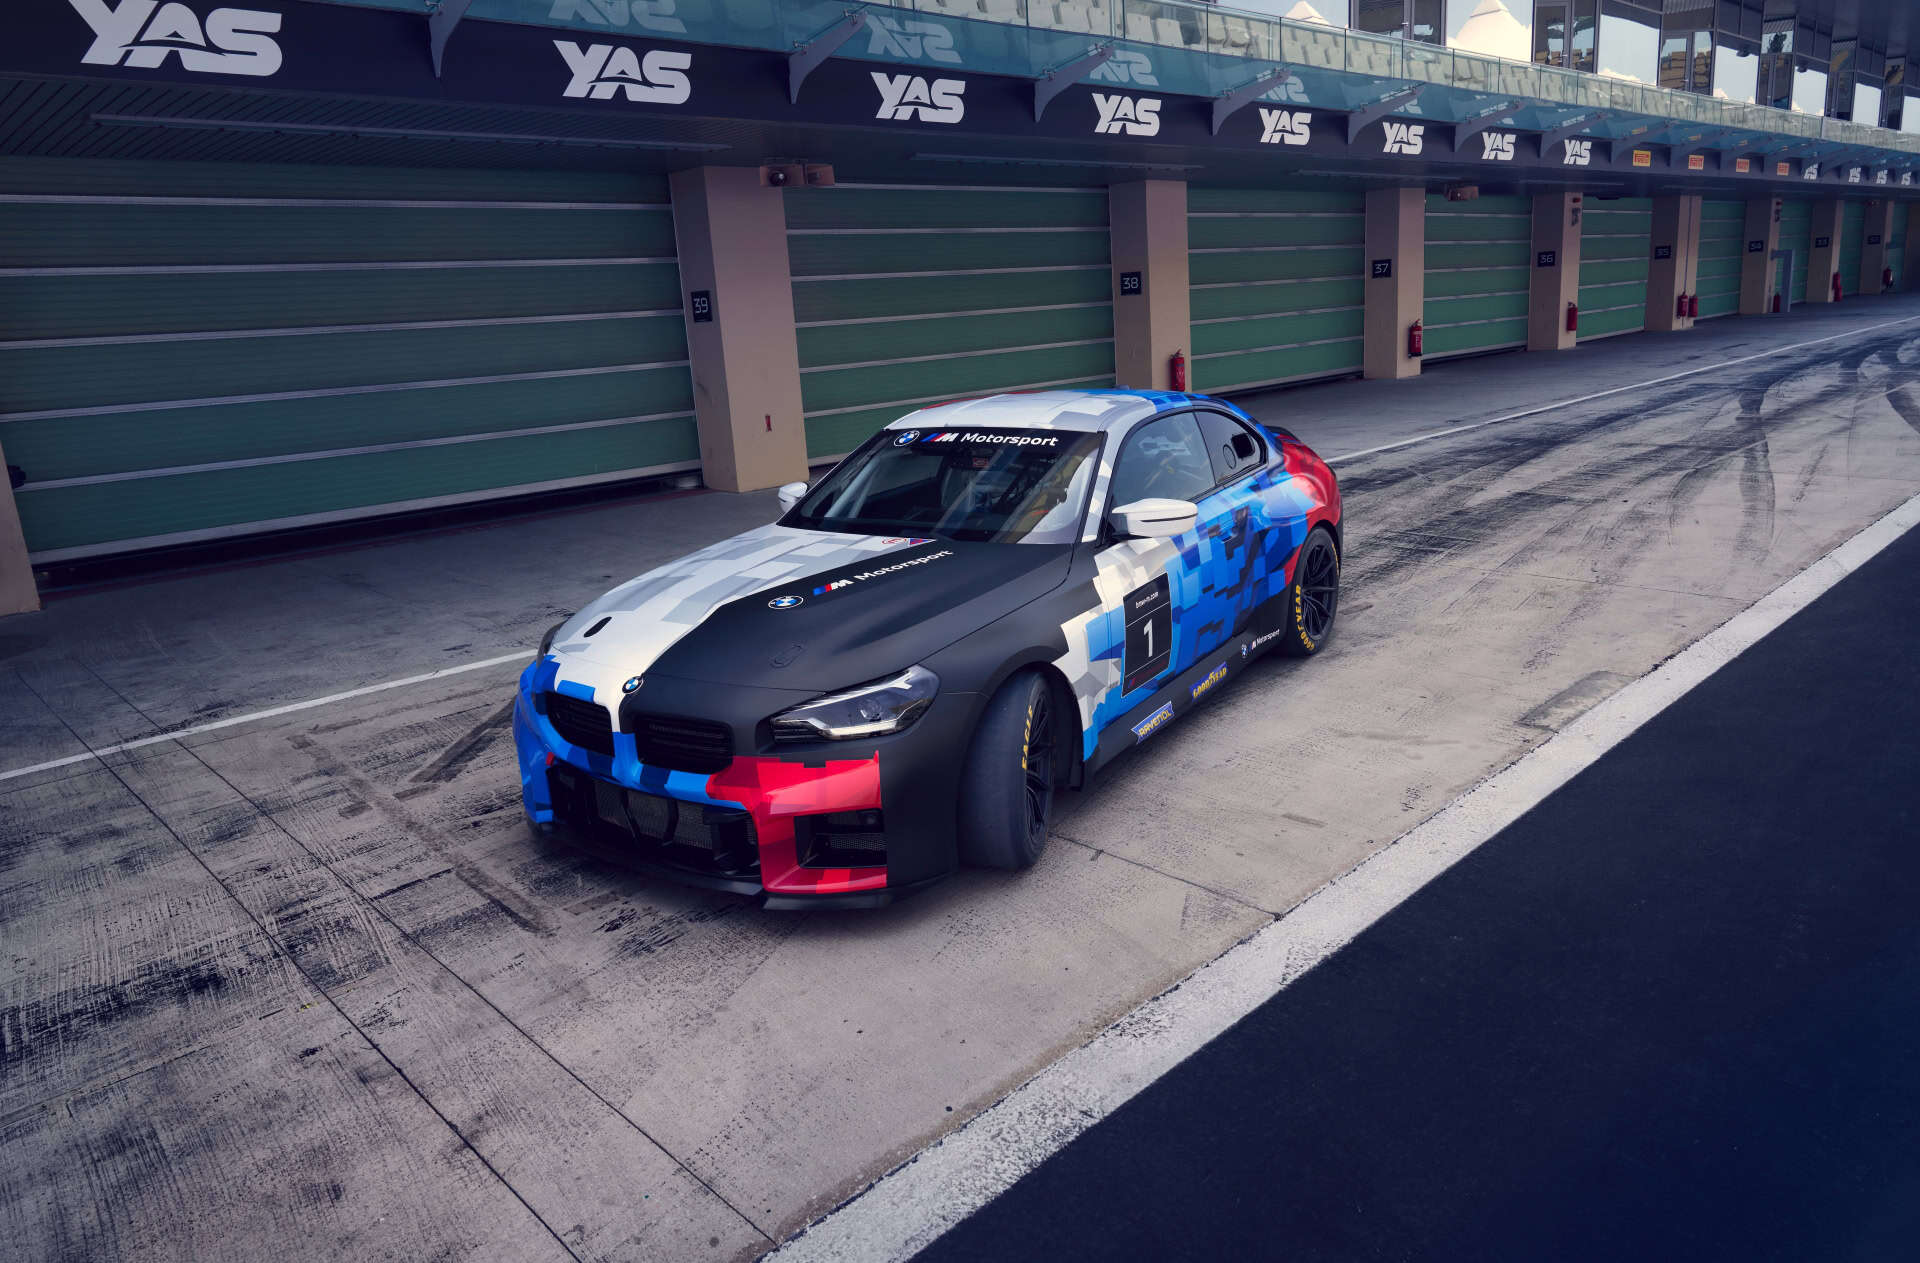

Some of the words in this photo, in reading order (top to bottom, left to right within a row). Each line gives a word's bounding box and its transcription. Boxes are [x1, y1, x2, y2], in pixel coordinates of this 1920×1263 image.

[69, 0, 282, 76] YAS
[553, 40, 692, 104] YAS
[870, 71, 966, 124] YAS
[1092, 92, 1161, 137] YAS
[1259, 108, 1312, 145] YAS
[1382, 121, 1425, 155] YAS
[1481, 131, 1516, 161] YAS
[1563, 138, 1592, 165] YAS
[1373, 262, 1390, 274] 37
[1540, 254, 1554, 264] 36
[1122, 276, 1139, 290] 38
[693, 297, 709, 314] 39
[960, 432, 1058, 446] Motorsport
[854, 550, 954, 581] Motorsport
[1143, 618, 1154, 658] 1
[1256, 629, 1280, 646] Motorsport
[1192, 667, 1228, 699] GOODYEAR
[1137, 708, 1173, 737] RAVENOL
